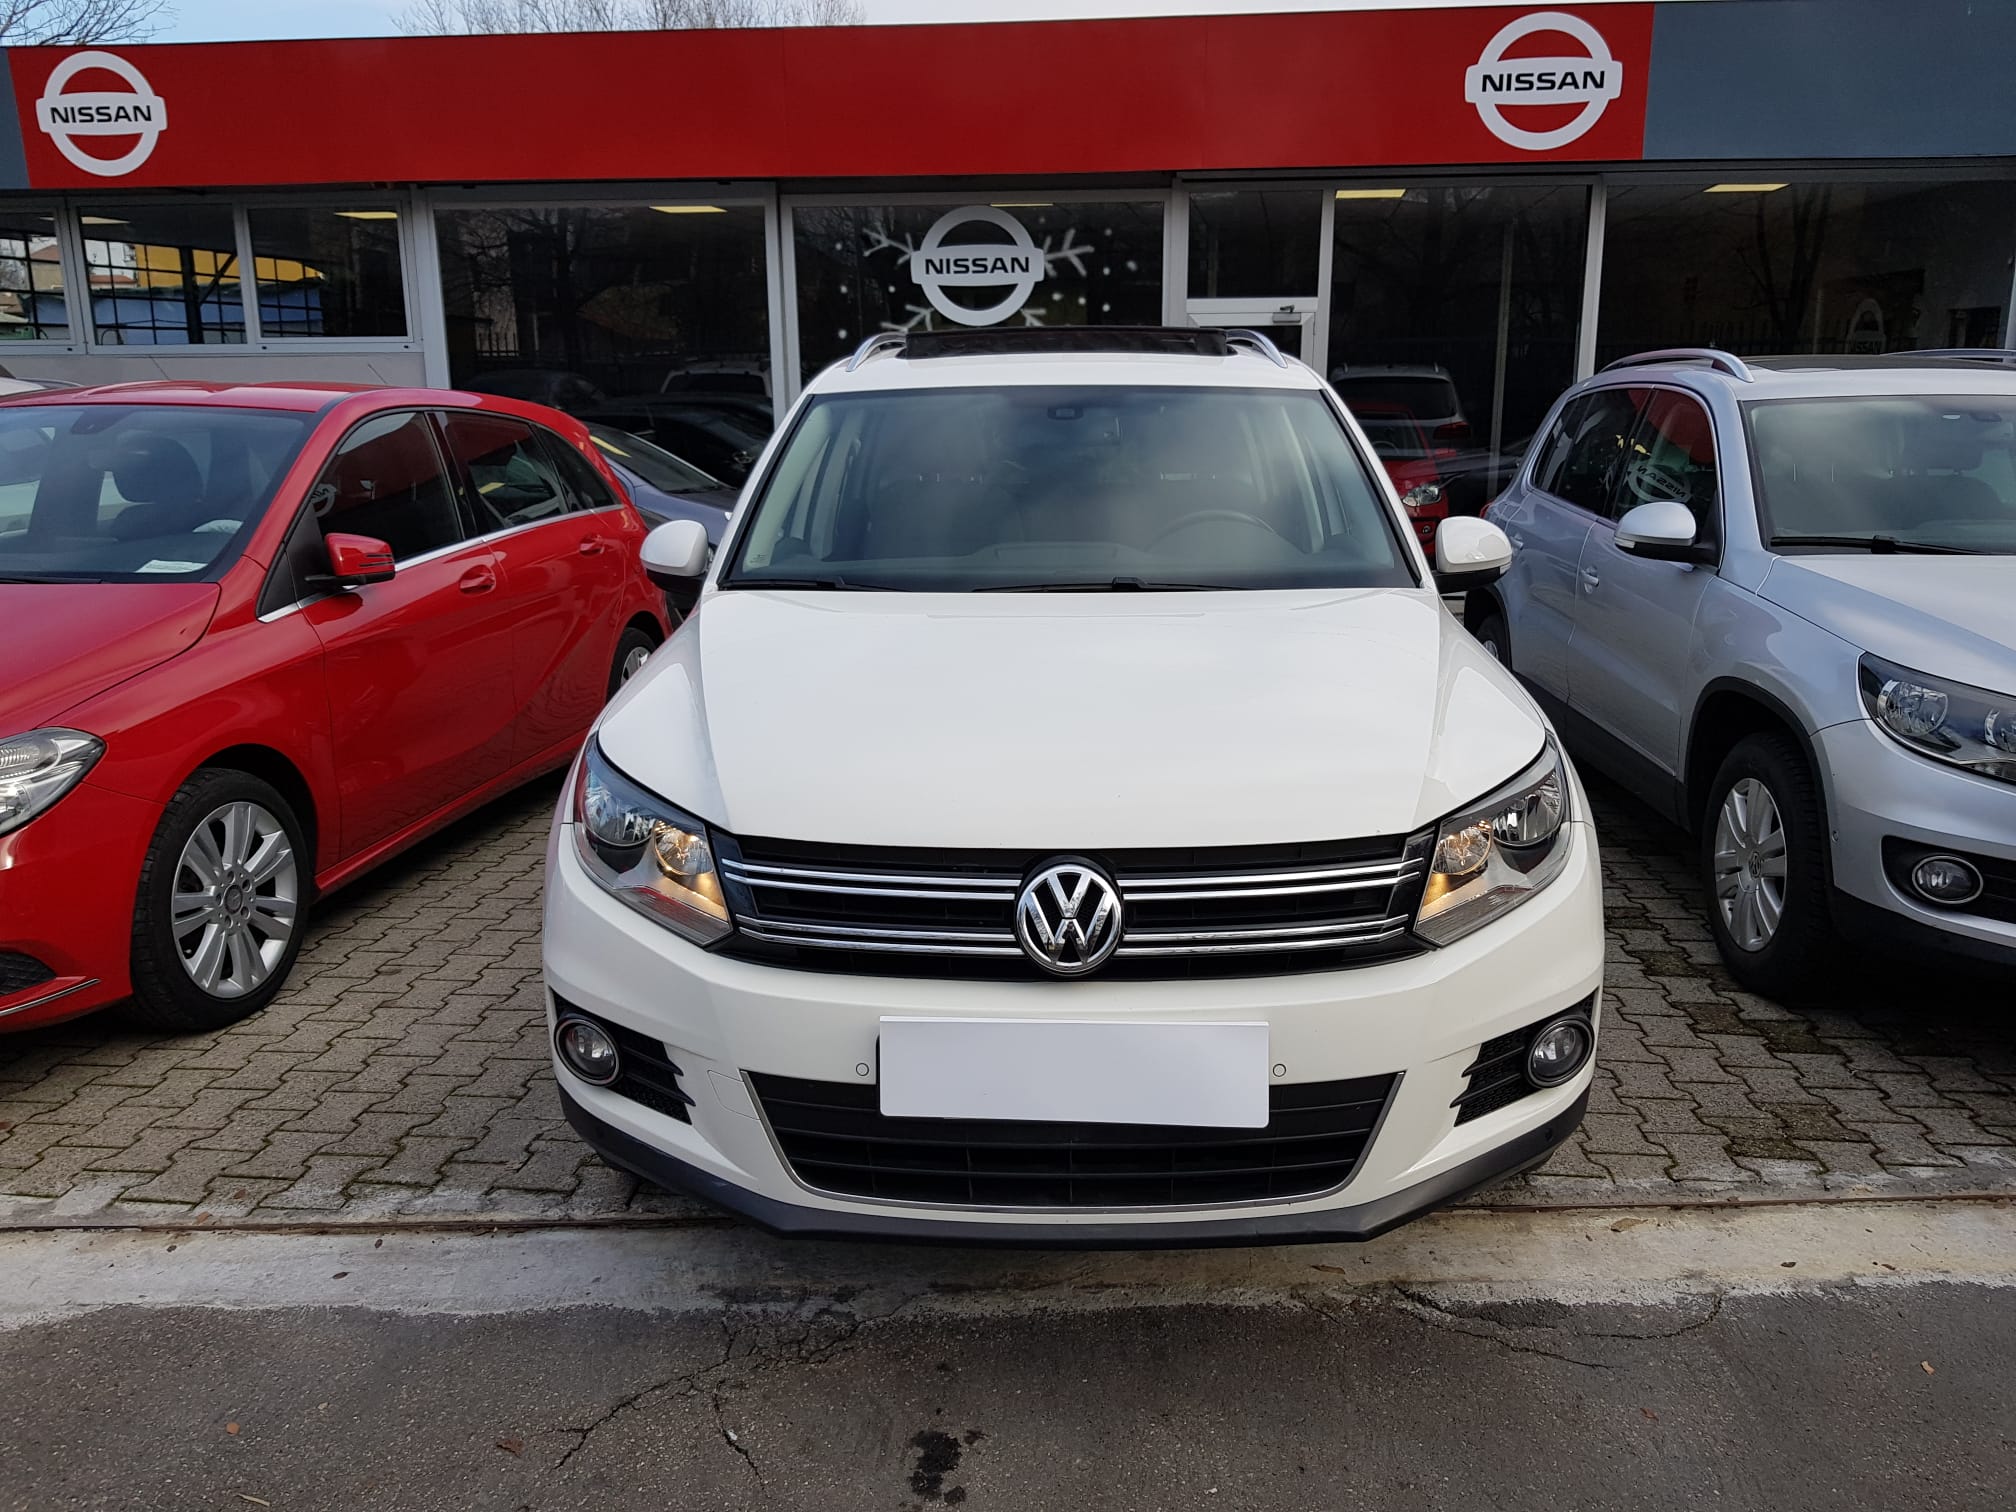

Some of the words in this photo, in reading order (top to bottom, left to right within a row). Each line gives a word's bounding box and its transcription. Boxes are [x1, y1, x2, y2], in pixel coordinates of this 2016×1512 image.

[1481, 70, 1605, 93] NISSAN
[49, 105, 152, 124] NISSAN
[925, 256, 1029, 275] NISSAN
